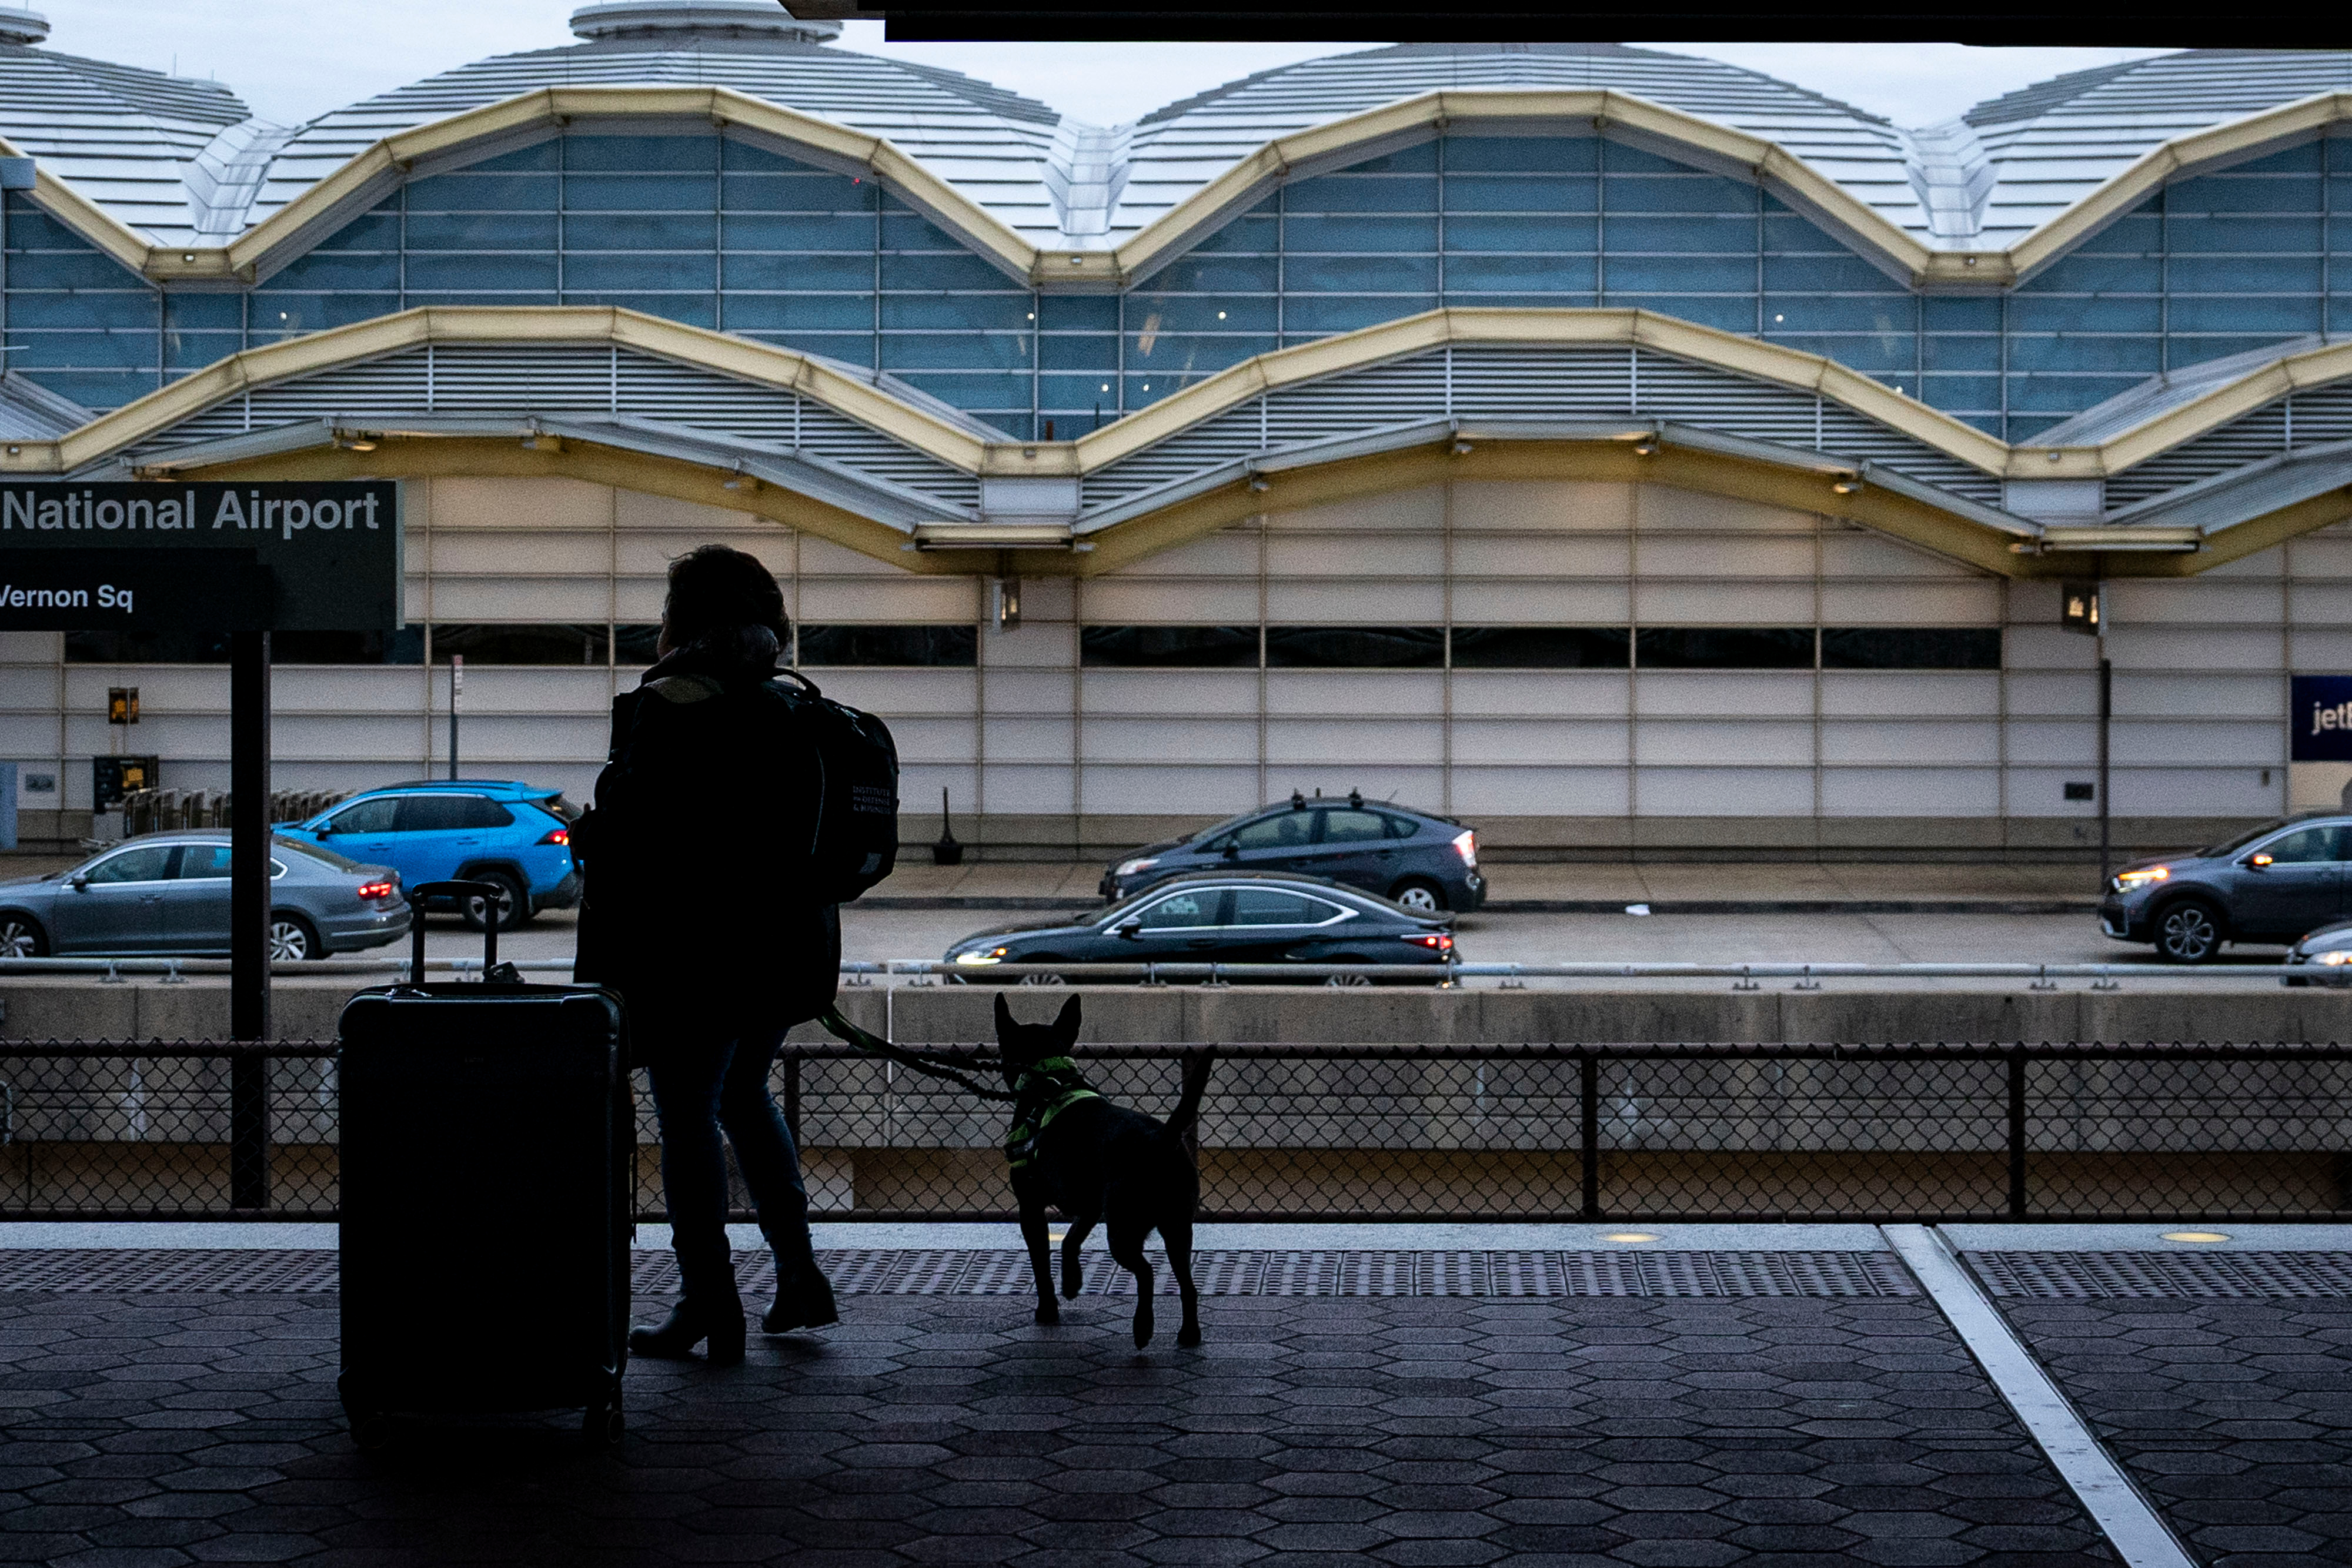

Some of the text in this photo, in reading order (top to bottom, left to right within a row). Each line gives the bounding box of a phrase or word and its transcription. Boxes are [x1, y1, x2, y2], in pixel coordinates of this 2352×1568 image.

[3, 490, 379, 540] National Airport
[98, 584, 133, 613] Sq
[853, 785, 890, 797] INSTITUTE
